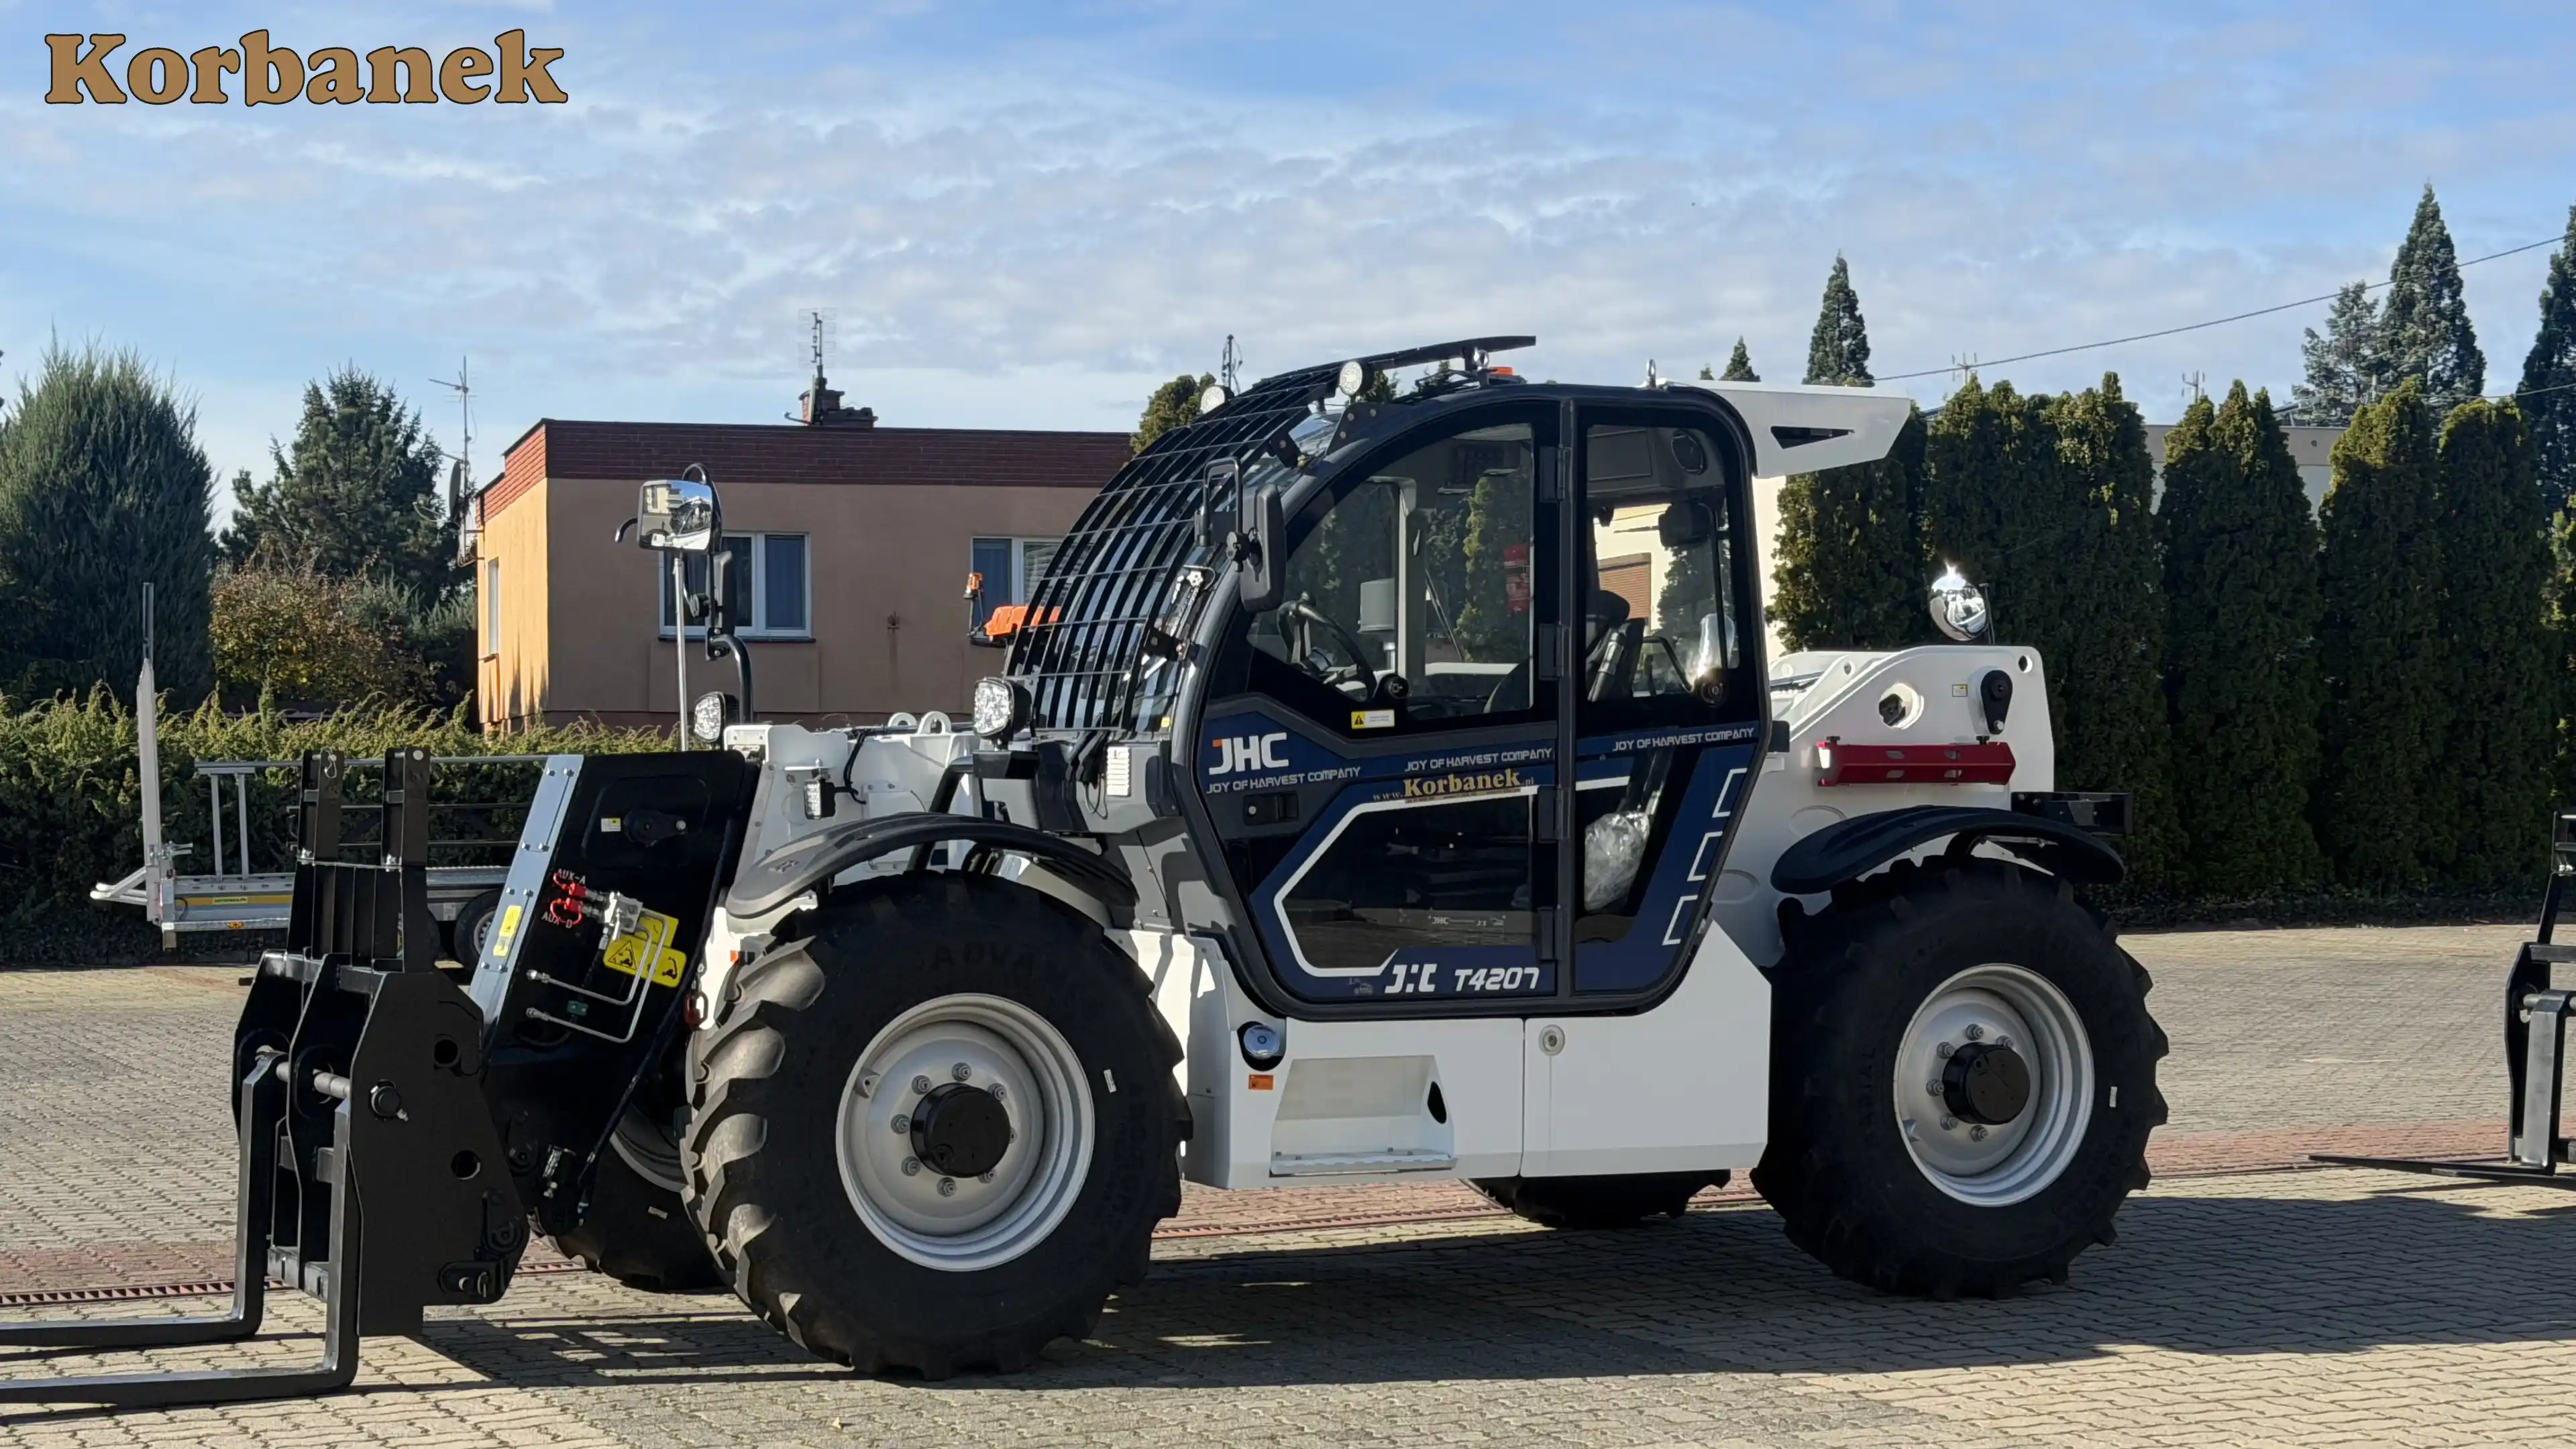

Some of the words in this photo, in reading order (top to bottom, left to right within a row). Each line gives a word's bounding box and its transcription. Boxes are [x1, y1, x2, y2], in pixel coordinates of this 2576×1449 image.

[1612, 740, 1634, 751] JOY
[1637, 739, 1651, 749] OF
[1653, 733, 1703, 747] HARVEST
[1705, 727, 1754, 741] COMPANY
[1209, 732, 1289, 775] JHC
[1405, 759, 1428, 772] JOY
[1430, 758, 1445, 769] OF
[1446, 753, 1499, 767] HARVEST
[1501, 748, 1552, 762] COMPANY
[1206, 782, 1230, 794] JOY
[1233, 780, 1248, 790] OF
[1250, 773, 1305, 788] HARVEST
[1308, 766, 1360, 782] COMPANY
[557, 868, 586, 885] AUX-A
[1454, 967, 1540, 991] T4207
